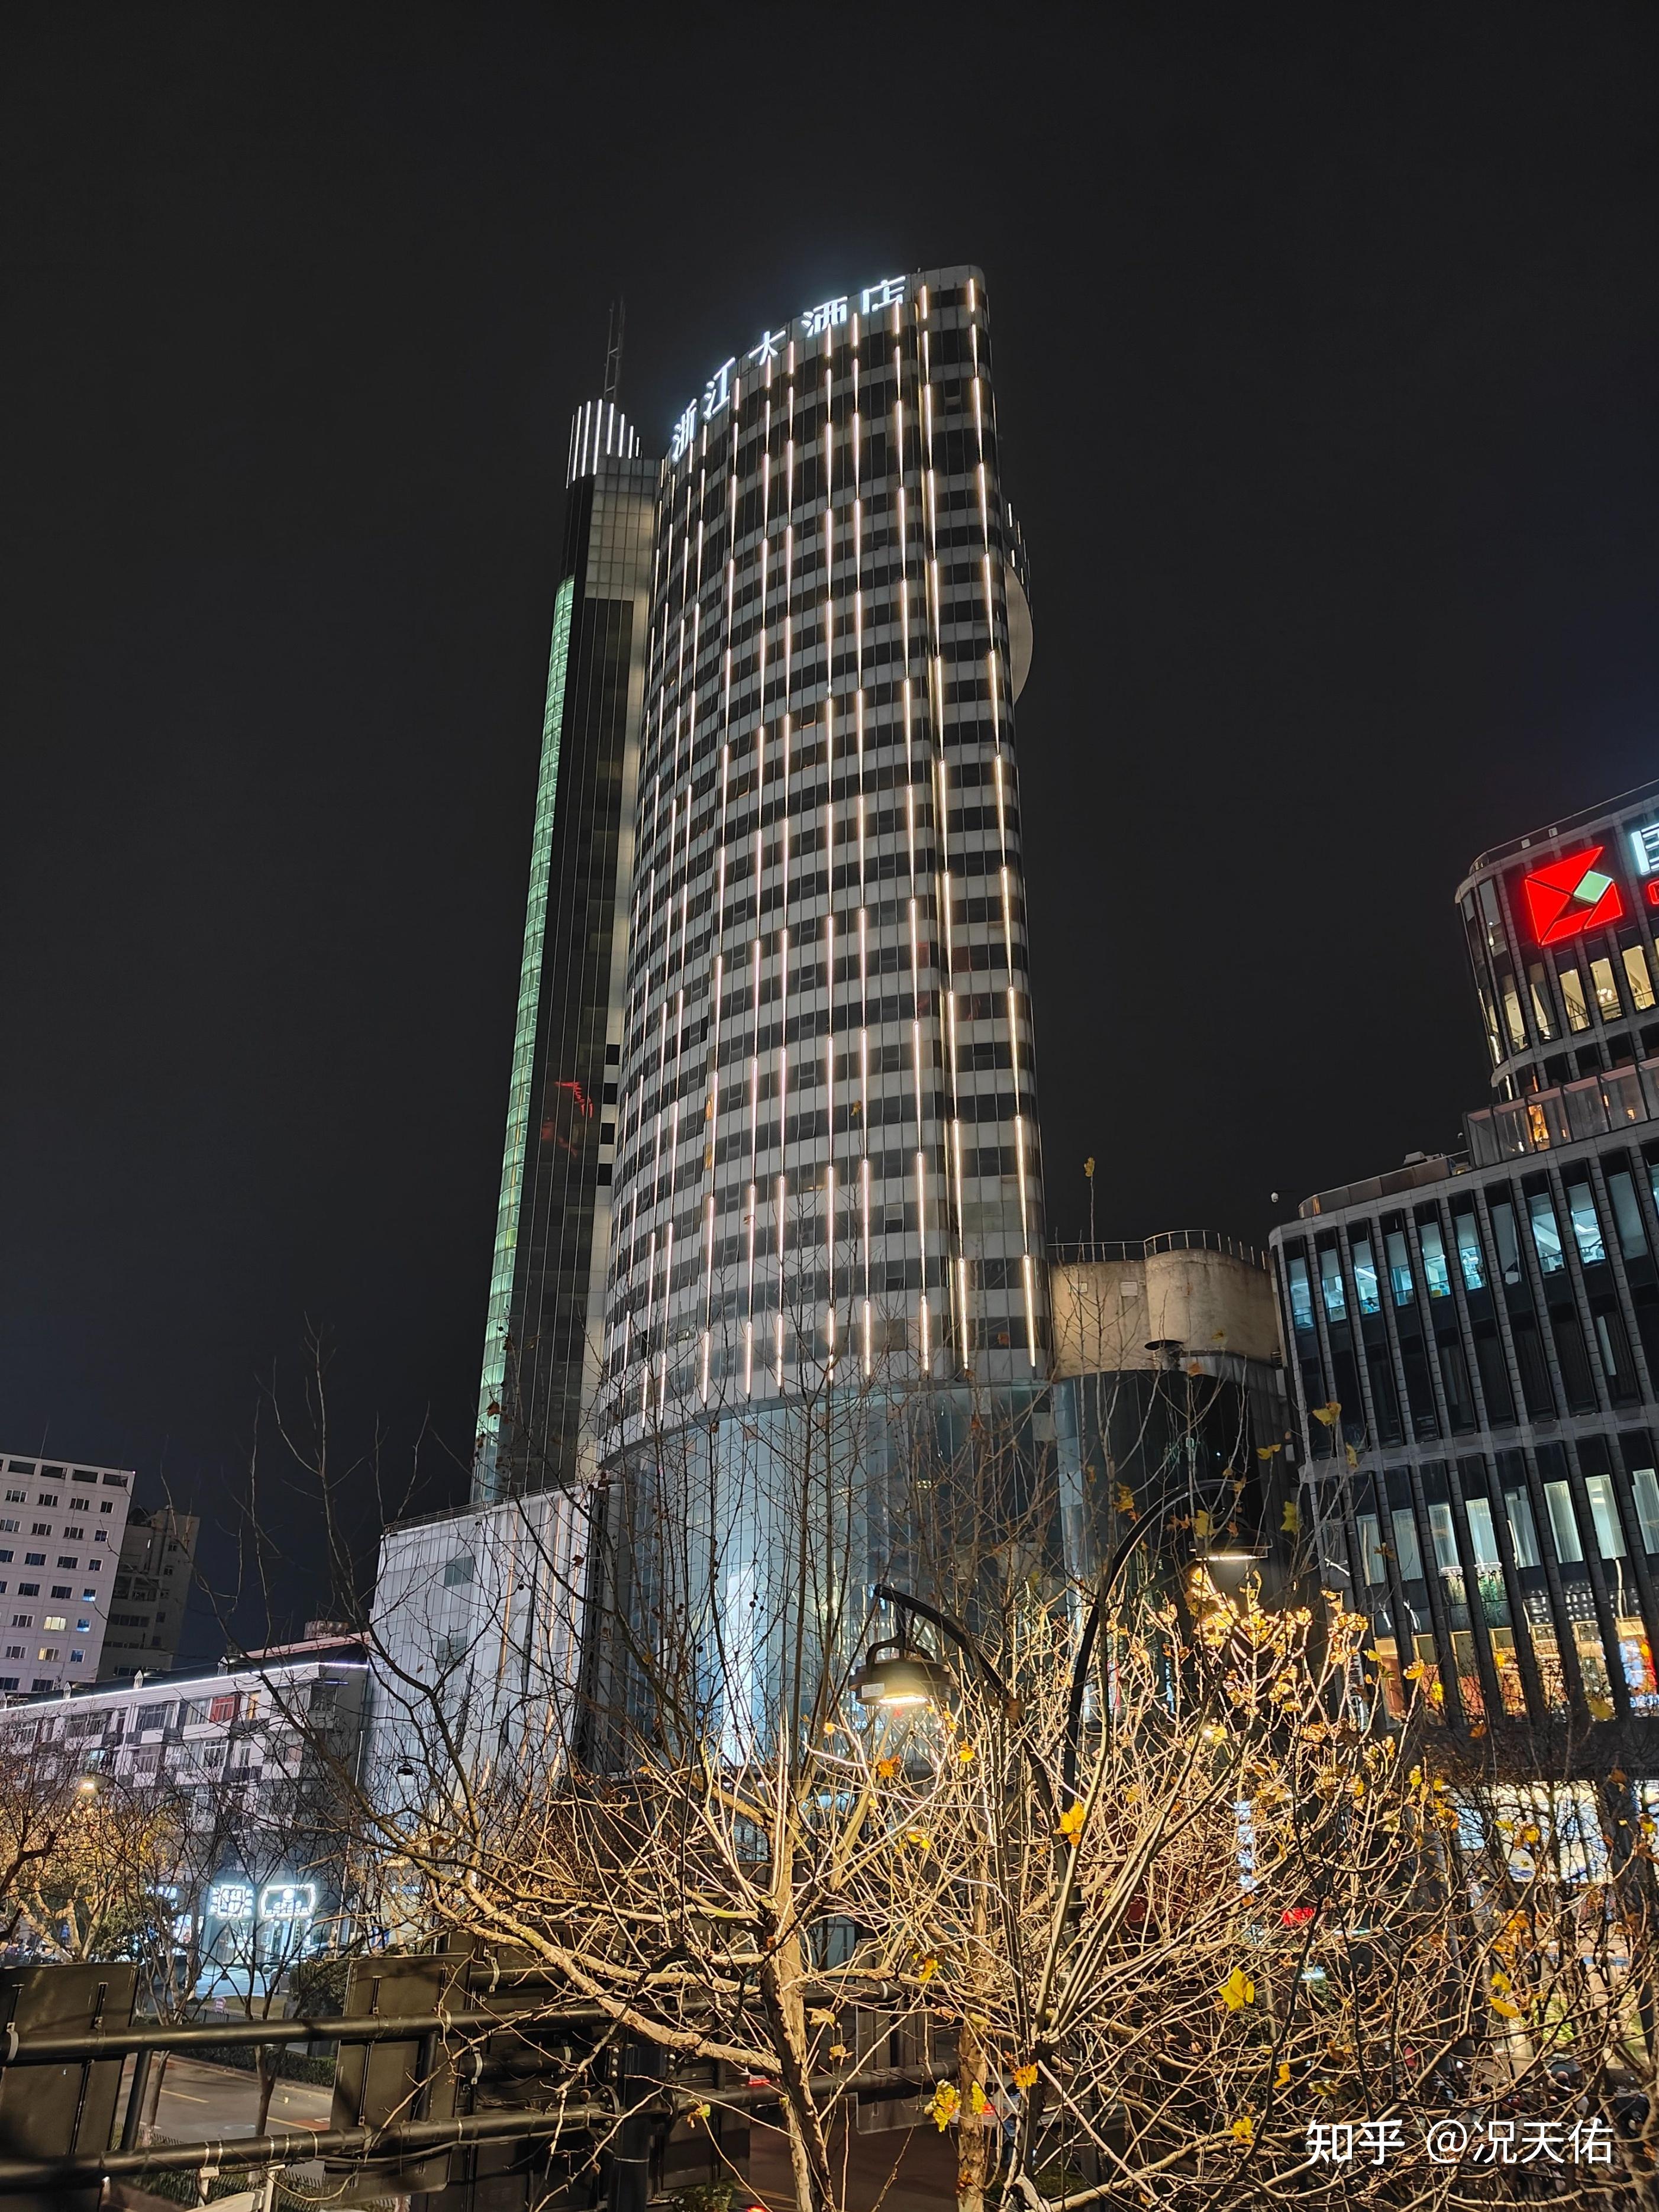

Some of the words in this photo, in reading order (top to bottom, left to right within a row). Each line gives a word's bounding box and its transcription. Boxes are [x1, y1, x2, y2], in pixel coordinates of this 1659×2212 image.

[672, 276, 906, 463] 浙江大酒店
